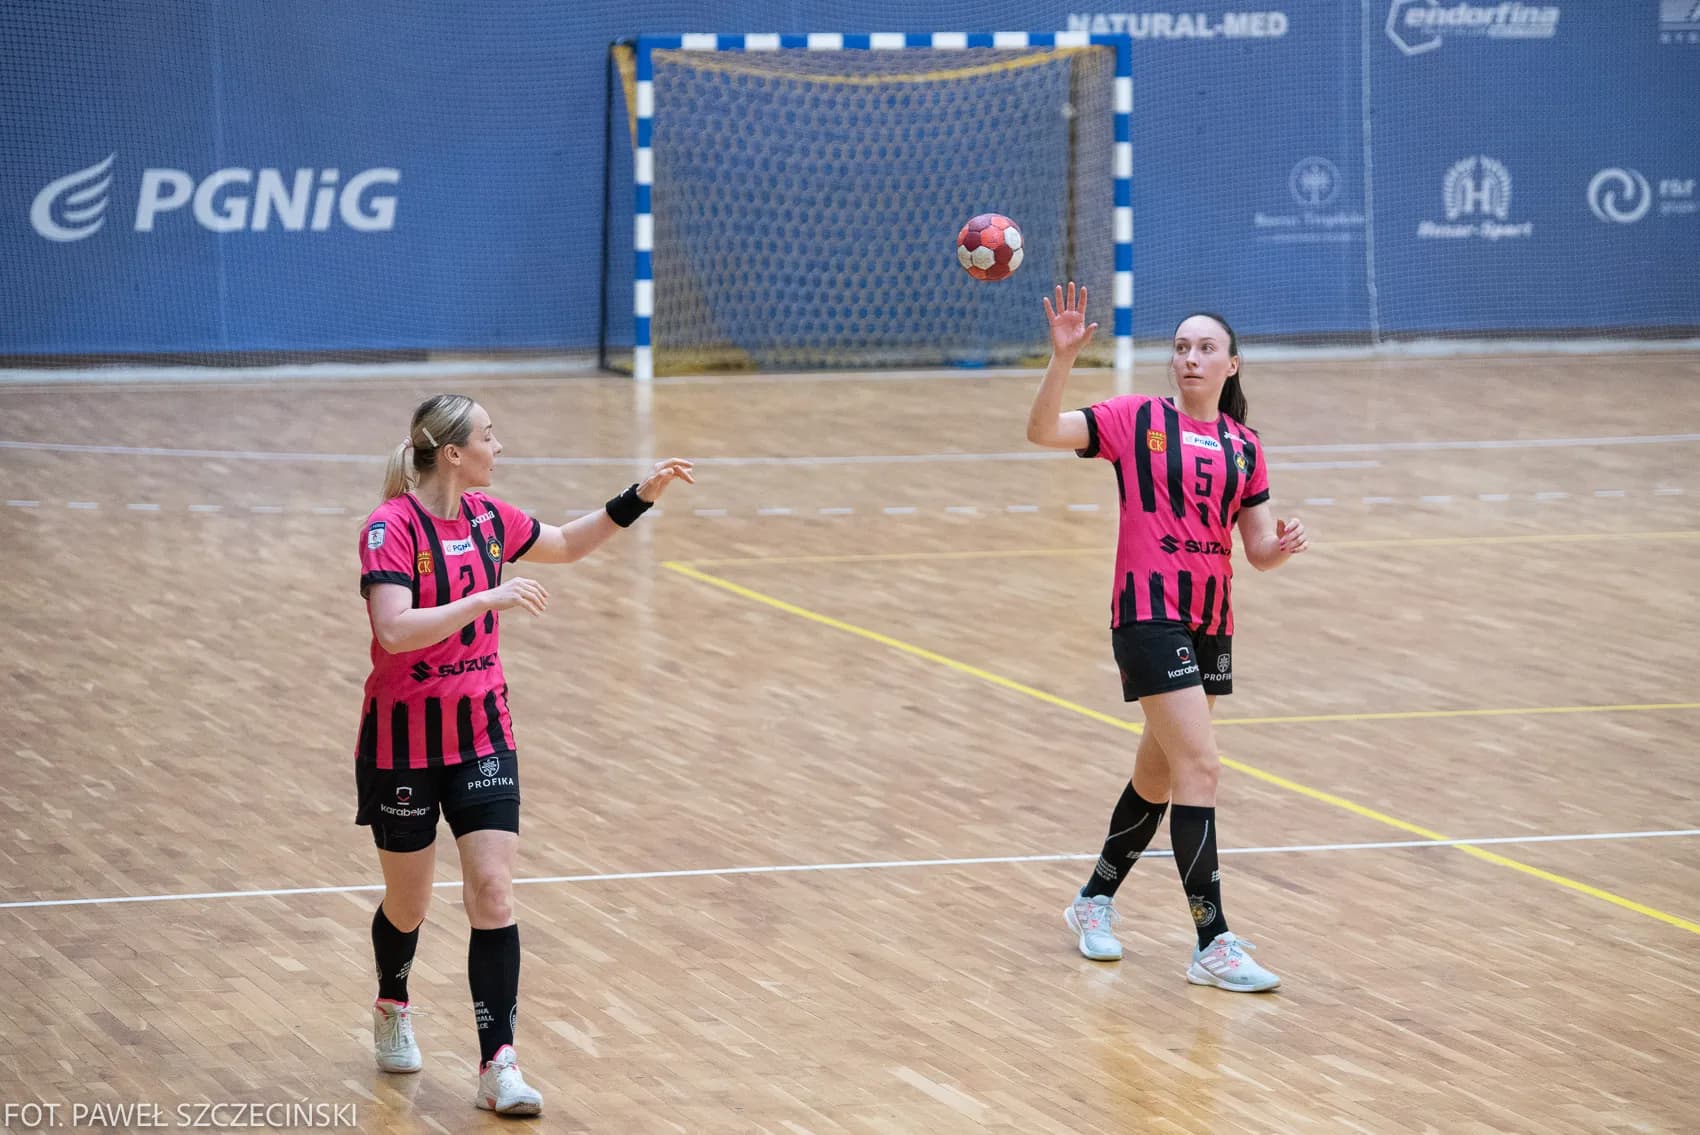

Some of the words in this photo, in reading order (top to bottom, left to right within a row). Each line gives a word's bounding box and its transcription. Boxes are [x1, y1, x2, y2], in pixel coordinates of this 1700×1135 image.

[1067, 12, 1287, 38] NATURAL-MED
[135, 167, 401, 233] PGNiG
[1149, 438, 1164, 452] CK
[1195, 456, 1213, 498] 5
[417, 560, 433, 574] CK
[467, 777, 515, 791] PROFIKA
[380, 804, 427, 818] karabela
